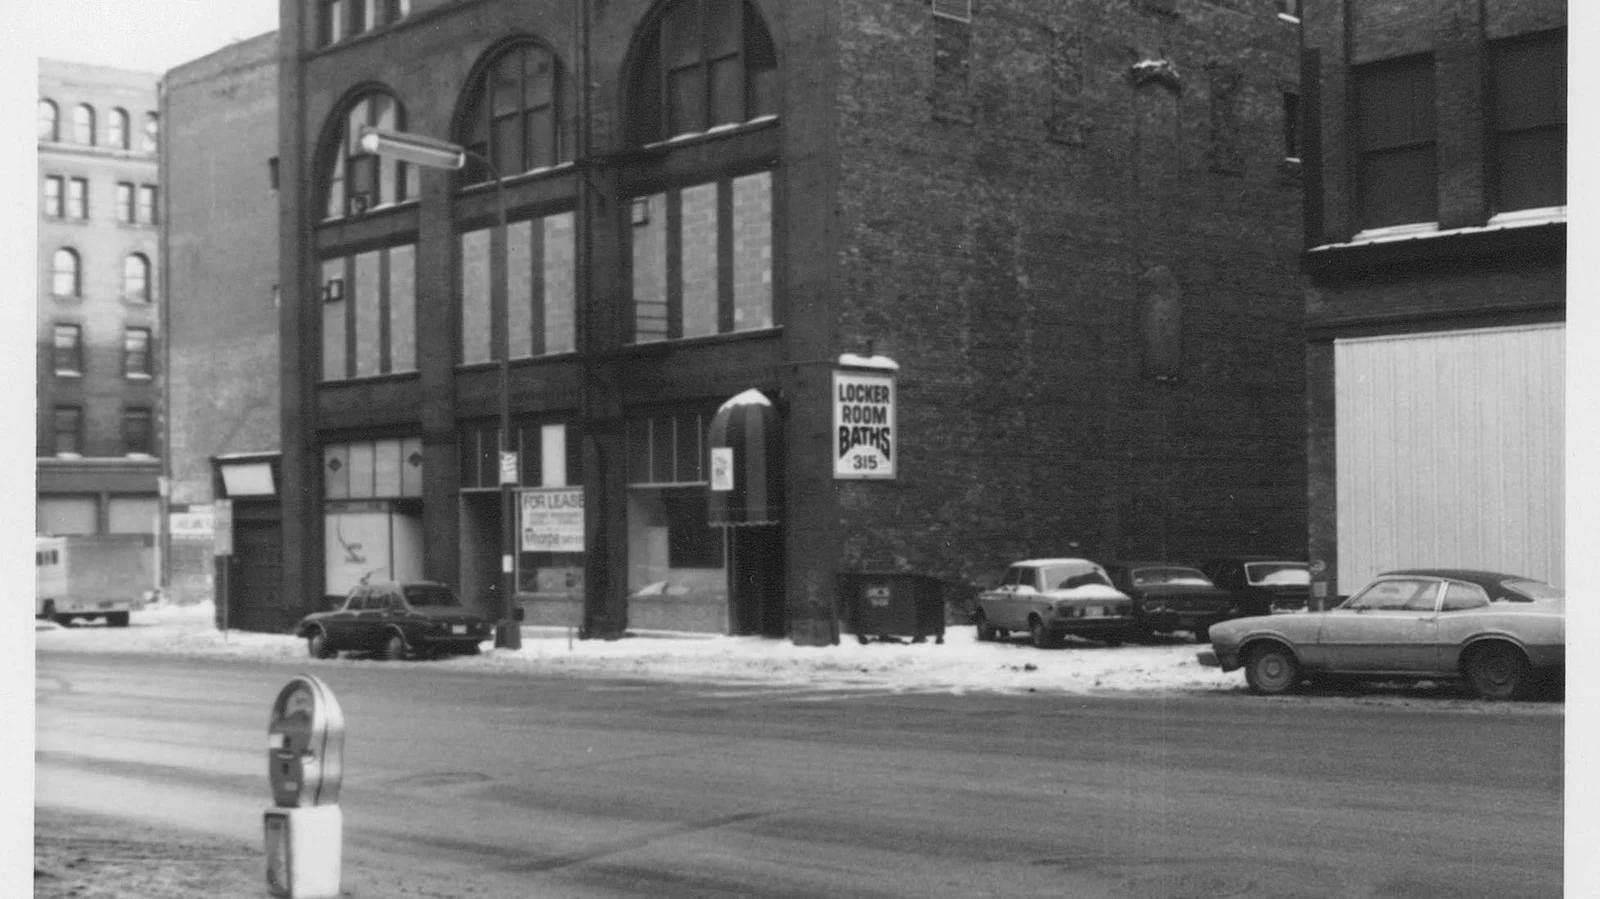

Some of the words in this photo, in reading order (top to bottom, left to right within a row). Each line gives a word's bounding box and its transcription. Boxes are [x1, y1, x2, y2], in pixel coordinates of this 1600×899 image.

[838, 384, 890, 404] LOCKER
[842, 405, 887, 424] ROOM
[839, 426, 890, 461] BATHS
[853, 455, 878, 470] 315
[523, 494, 545, 509] FOR
[548, 493, 584, 509] LEASE
